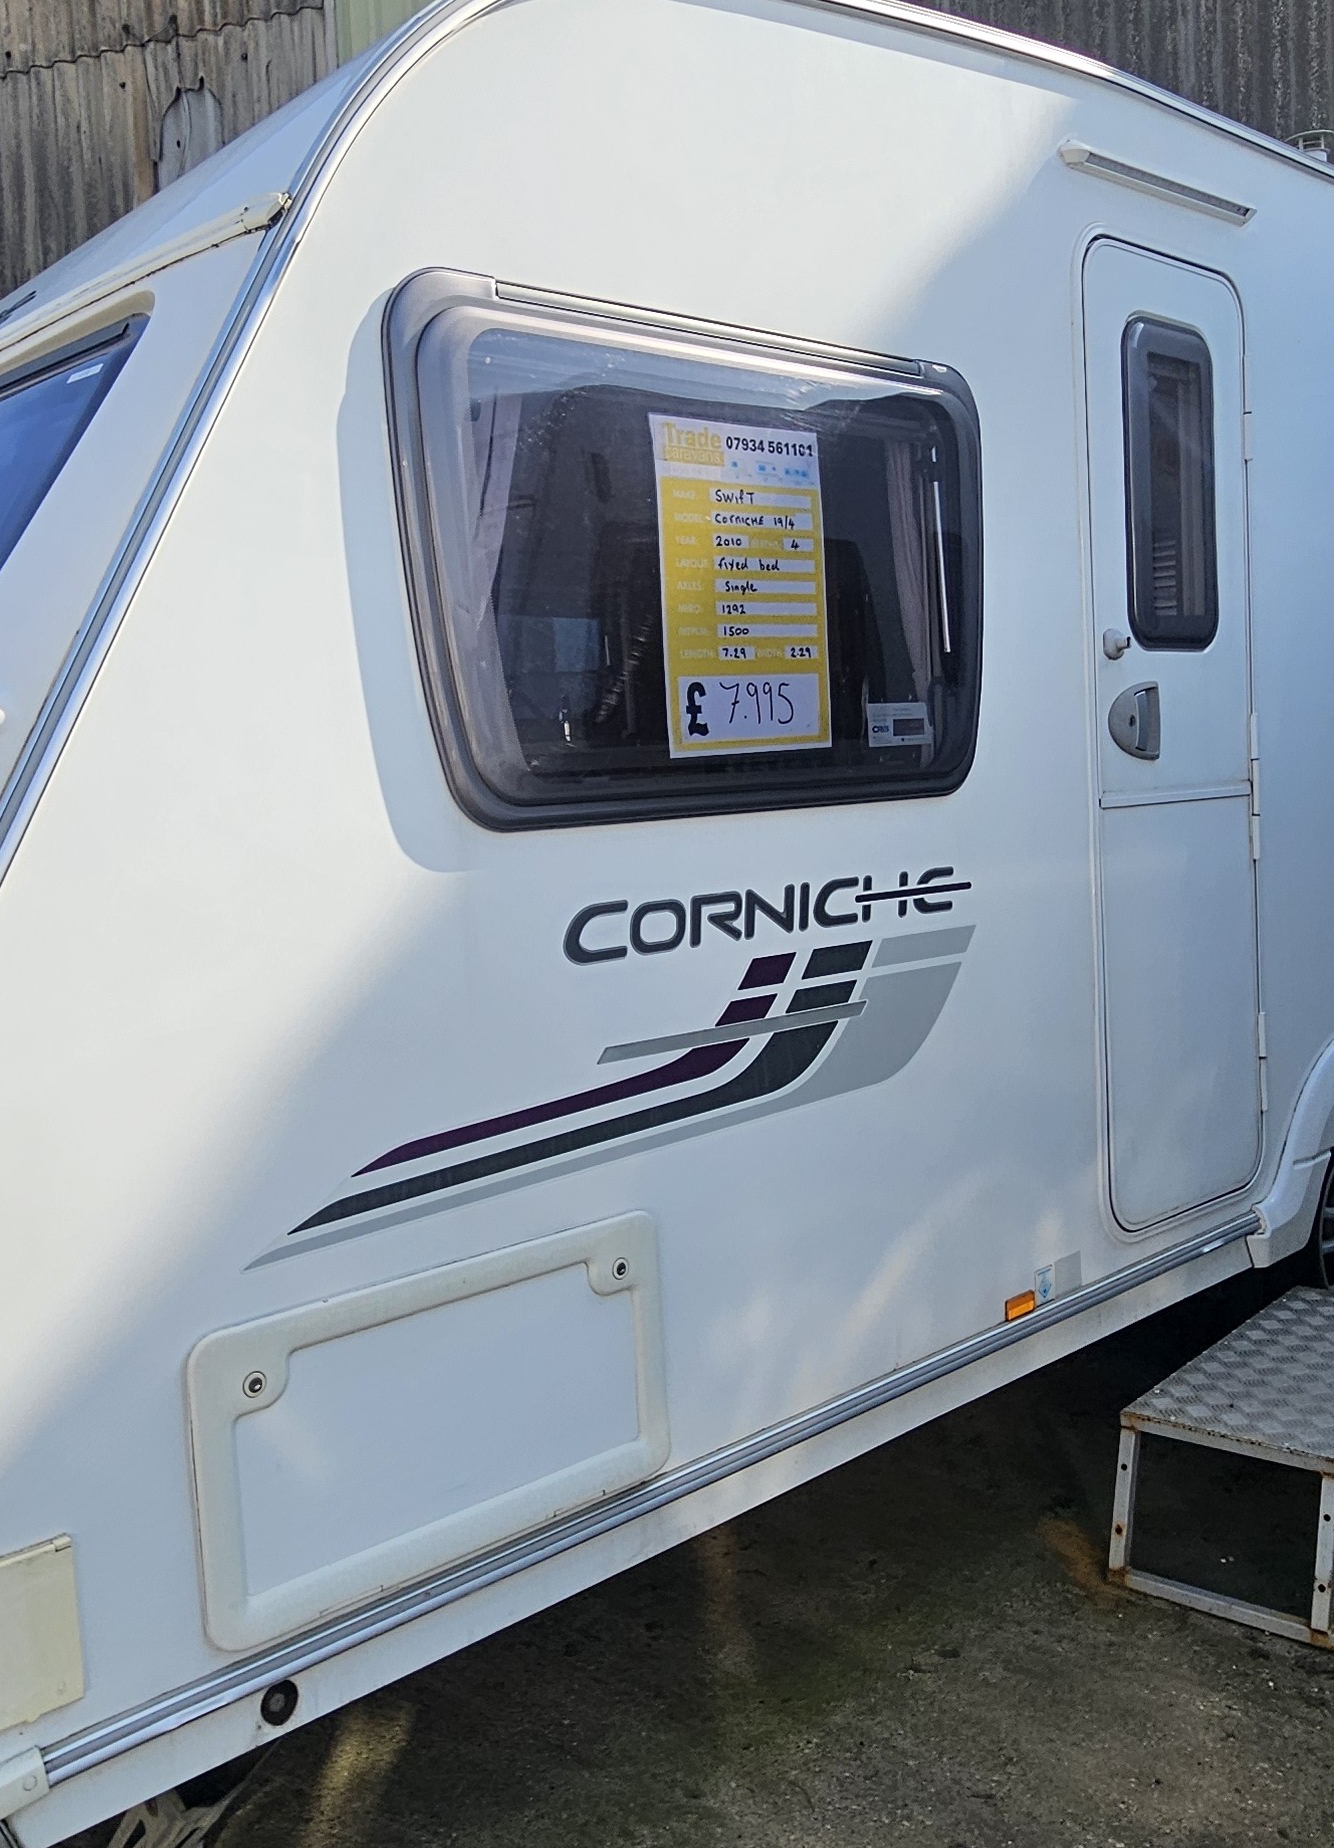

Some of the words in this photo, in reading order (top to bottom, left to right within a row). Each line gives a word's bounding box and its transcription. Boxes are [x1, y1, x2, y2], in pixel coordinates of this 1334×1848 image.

[663, 422, 722, 449] Trade
[726, 436, 765, 453] 07934
[768, 441, 813, 457] 561101
[773, 515, 795, 530] 19/4
[715, 535, 742, 547] 2010
[790, 539, 800, 551] 4
[717, 556, 748, 571] fixed
[758, 558, 780, 571] bed
[725, 581, 757, 595] Single
[722, 604, 746, 615] 1292
[723, 625, 750, 637] 1500
[722, 647, 747, 660] 7.29
[790, 647, 811, 659] 2.29
[685, 681, 710, 737] £
[562, 866, 973, 966] CORNICHE
